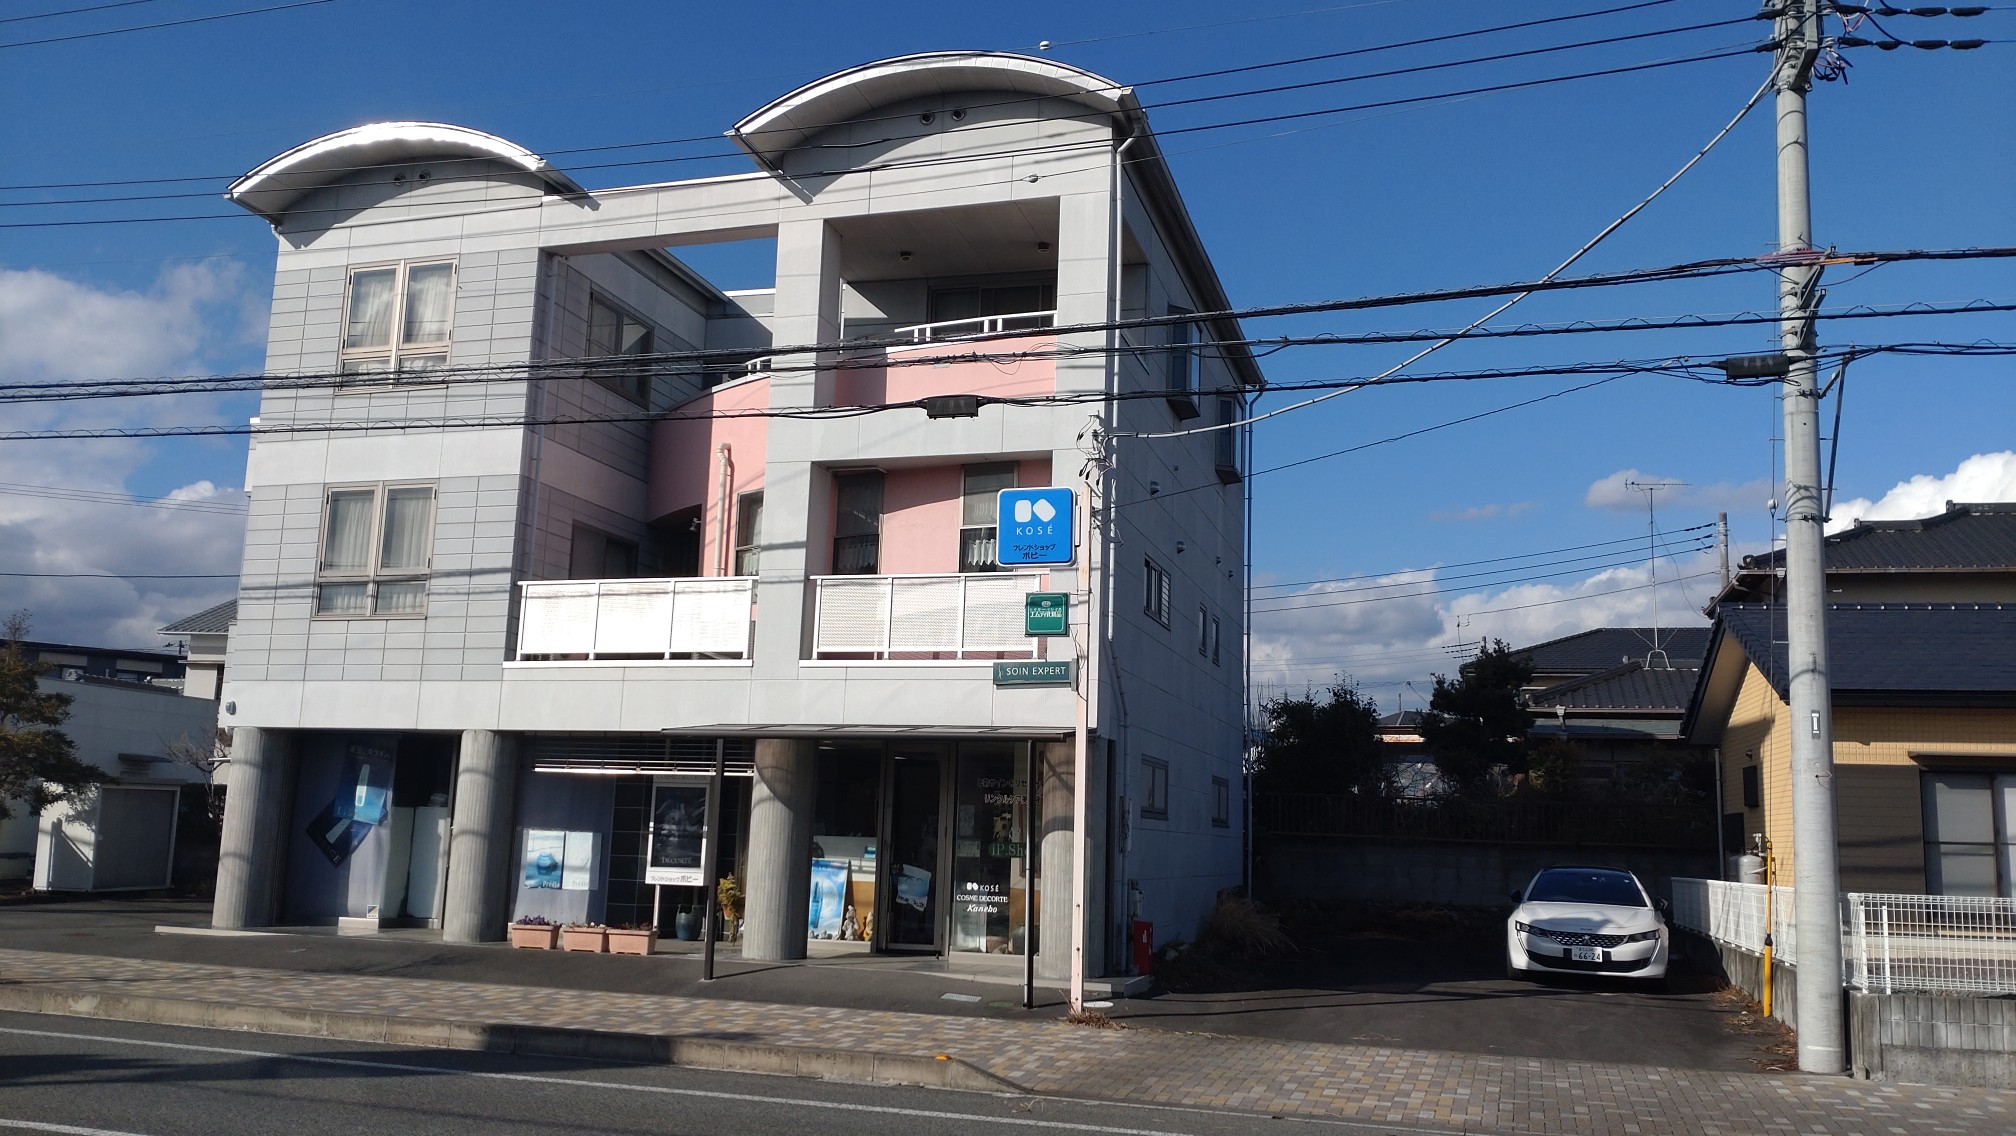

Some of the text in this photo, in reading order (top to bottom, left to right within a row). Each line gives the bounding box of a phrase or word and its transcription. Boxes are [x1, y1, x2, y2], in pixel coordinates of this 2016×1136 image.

[1016, 524, 1053, 536] KOSÉ
[1013, 543, 1056, 552] フレンドショップ
[1006, 666, 1066, 676] SOIN EXPERT
[991, 843, 1027, 857] iP.Sh
[979, 883, 1000, 892] KOSÉ
[956, 894, 978, 902] COSME
[966, 903, 998, 913] Kanebo
[1579, 952, 1600, 960] 66-24
